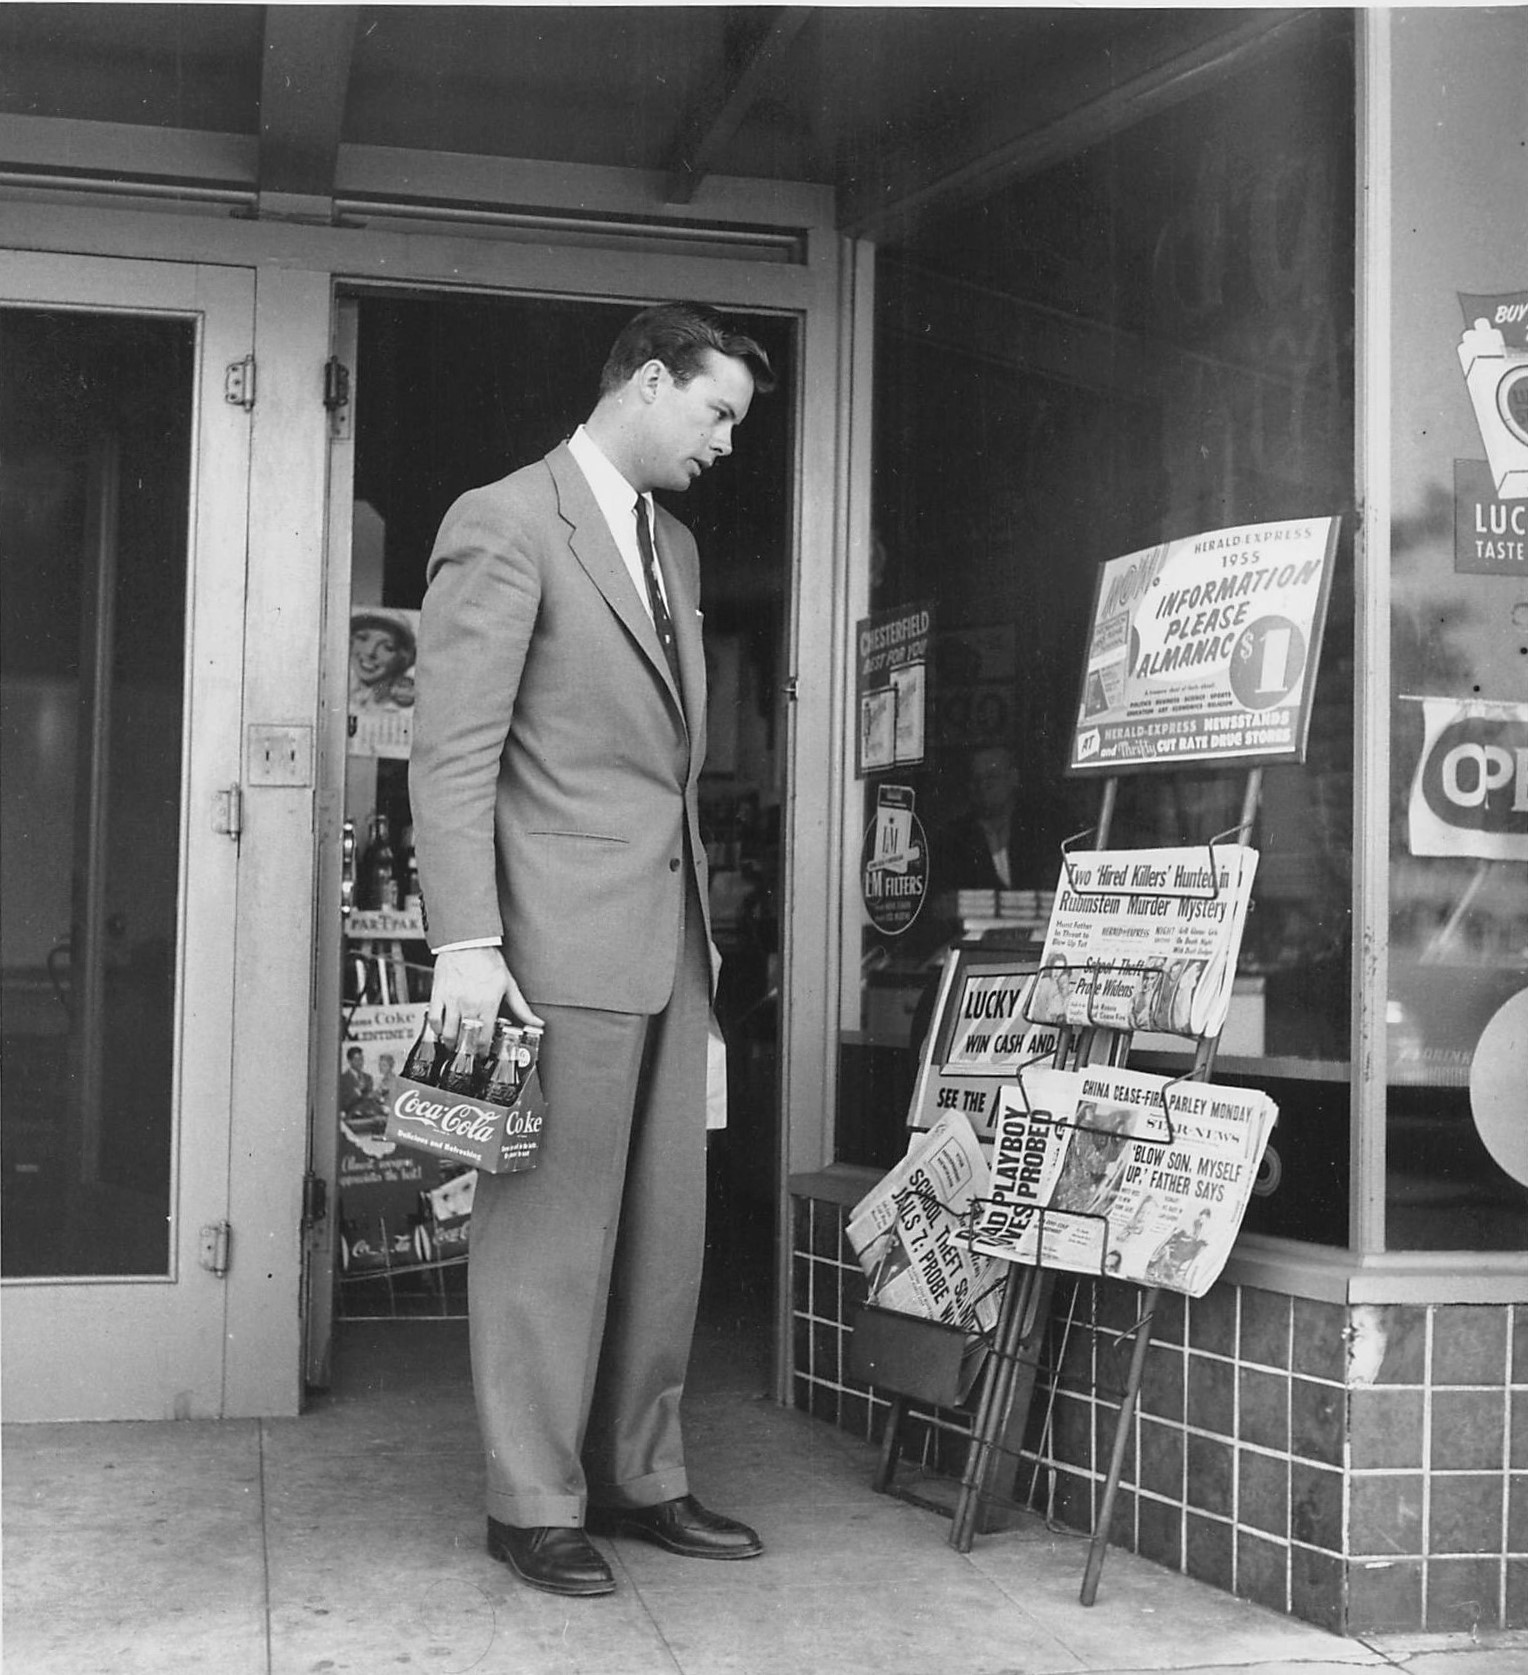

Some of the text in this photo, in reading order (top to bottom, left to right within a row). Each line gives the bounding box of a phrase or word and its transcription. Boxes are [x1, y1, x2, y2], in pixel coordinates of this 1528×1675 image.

[1495, 303, 1528, 323] BUY
[1222, 552, 1260, 567] 1955
[1475, 540, 1524, 560] TASTE
[1156, 559, 1321, 619] INFORMATION
[860, 610, 929, 657] CHESTERFIELD
[1164, 601, 1250, 644] PLEASE
[1137, 632, 1235, 679] ALMANAC
[1241, 628, 1292, 693] $1
[1130, 691, 1231, 707] POLITICS BUSINESS SCIENCE SPORTS
[1172, 703, 1203, 712] ECONOMICS
[1203, 711, 1290, 731] NEWSSTANDS
[1100, 729, 1290, 760] and Thrifty CUT RATE DRUG STORES
[886, 876, 922, 896] FILTERS
[1069, 864, 1092, 886] Two
[1174, 865, 1217, 888] Hunted
[1219, 865, 1229, 888] in
[1060, 890, 1227, 922] Rubinstein Murder Mystery
[1075, 978, 1134, 998] Proe Widens
[375, 1012, 415, 1024] Coke
[965, 989, 1021, 1019] LUCKY
[965, 1034, 991, 1053] WIN
[994, 1034, 1026, 1053] CASH
[1027, 1034, 1055, 1053] AND
[394, 1089, 501, 1143] Coca-Cola
[937, 1088, 959, 1109] SEE
[963, 1091, 986, 1113] THE
[1082, 1079, 1253, 1123] CHINA CEASE-FIRE PARLEY MONDAY
[506, 1110, 542, 1135] Coke
[397, 1129, 428, 1144] Delicious
[430, 1140, 443, 1149] and
[444, 1143, 482, 1161] Refreshing
[994, 1105, 1028, 1203] PLAYBOY
[1017, 1109, 1053, 1200] PROBED
[1133, 1144, 1165, 1167] 'BLOW
[1197, 1157, 1243, 1182] MYSELF
[1150, 1170, 1191, 1196] FATHER
[1195, 1180, 1225, 1202] SAYS
[909, 1169, 943, 1229] SCHOOL
[935, 1226, 963, 1278] THEFT
[891, 1187, 921, 1231] JAILS
[919, 1249, 950, 1304] PROBE
